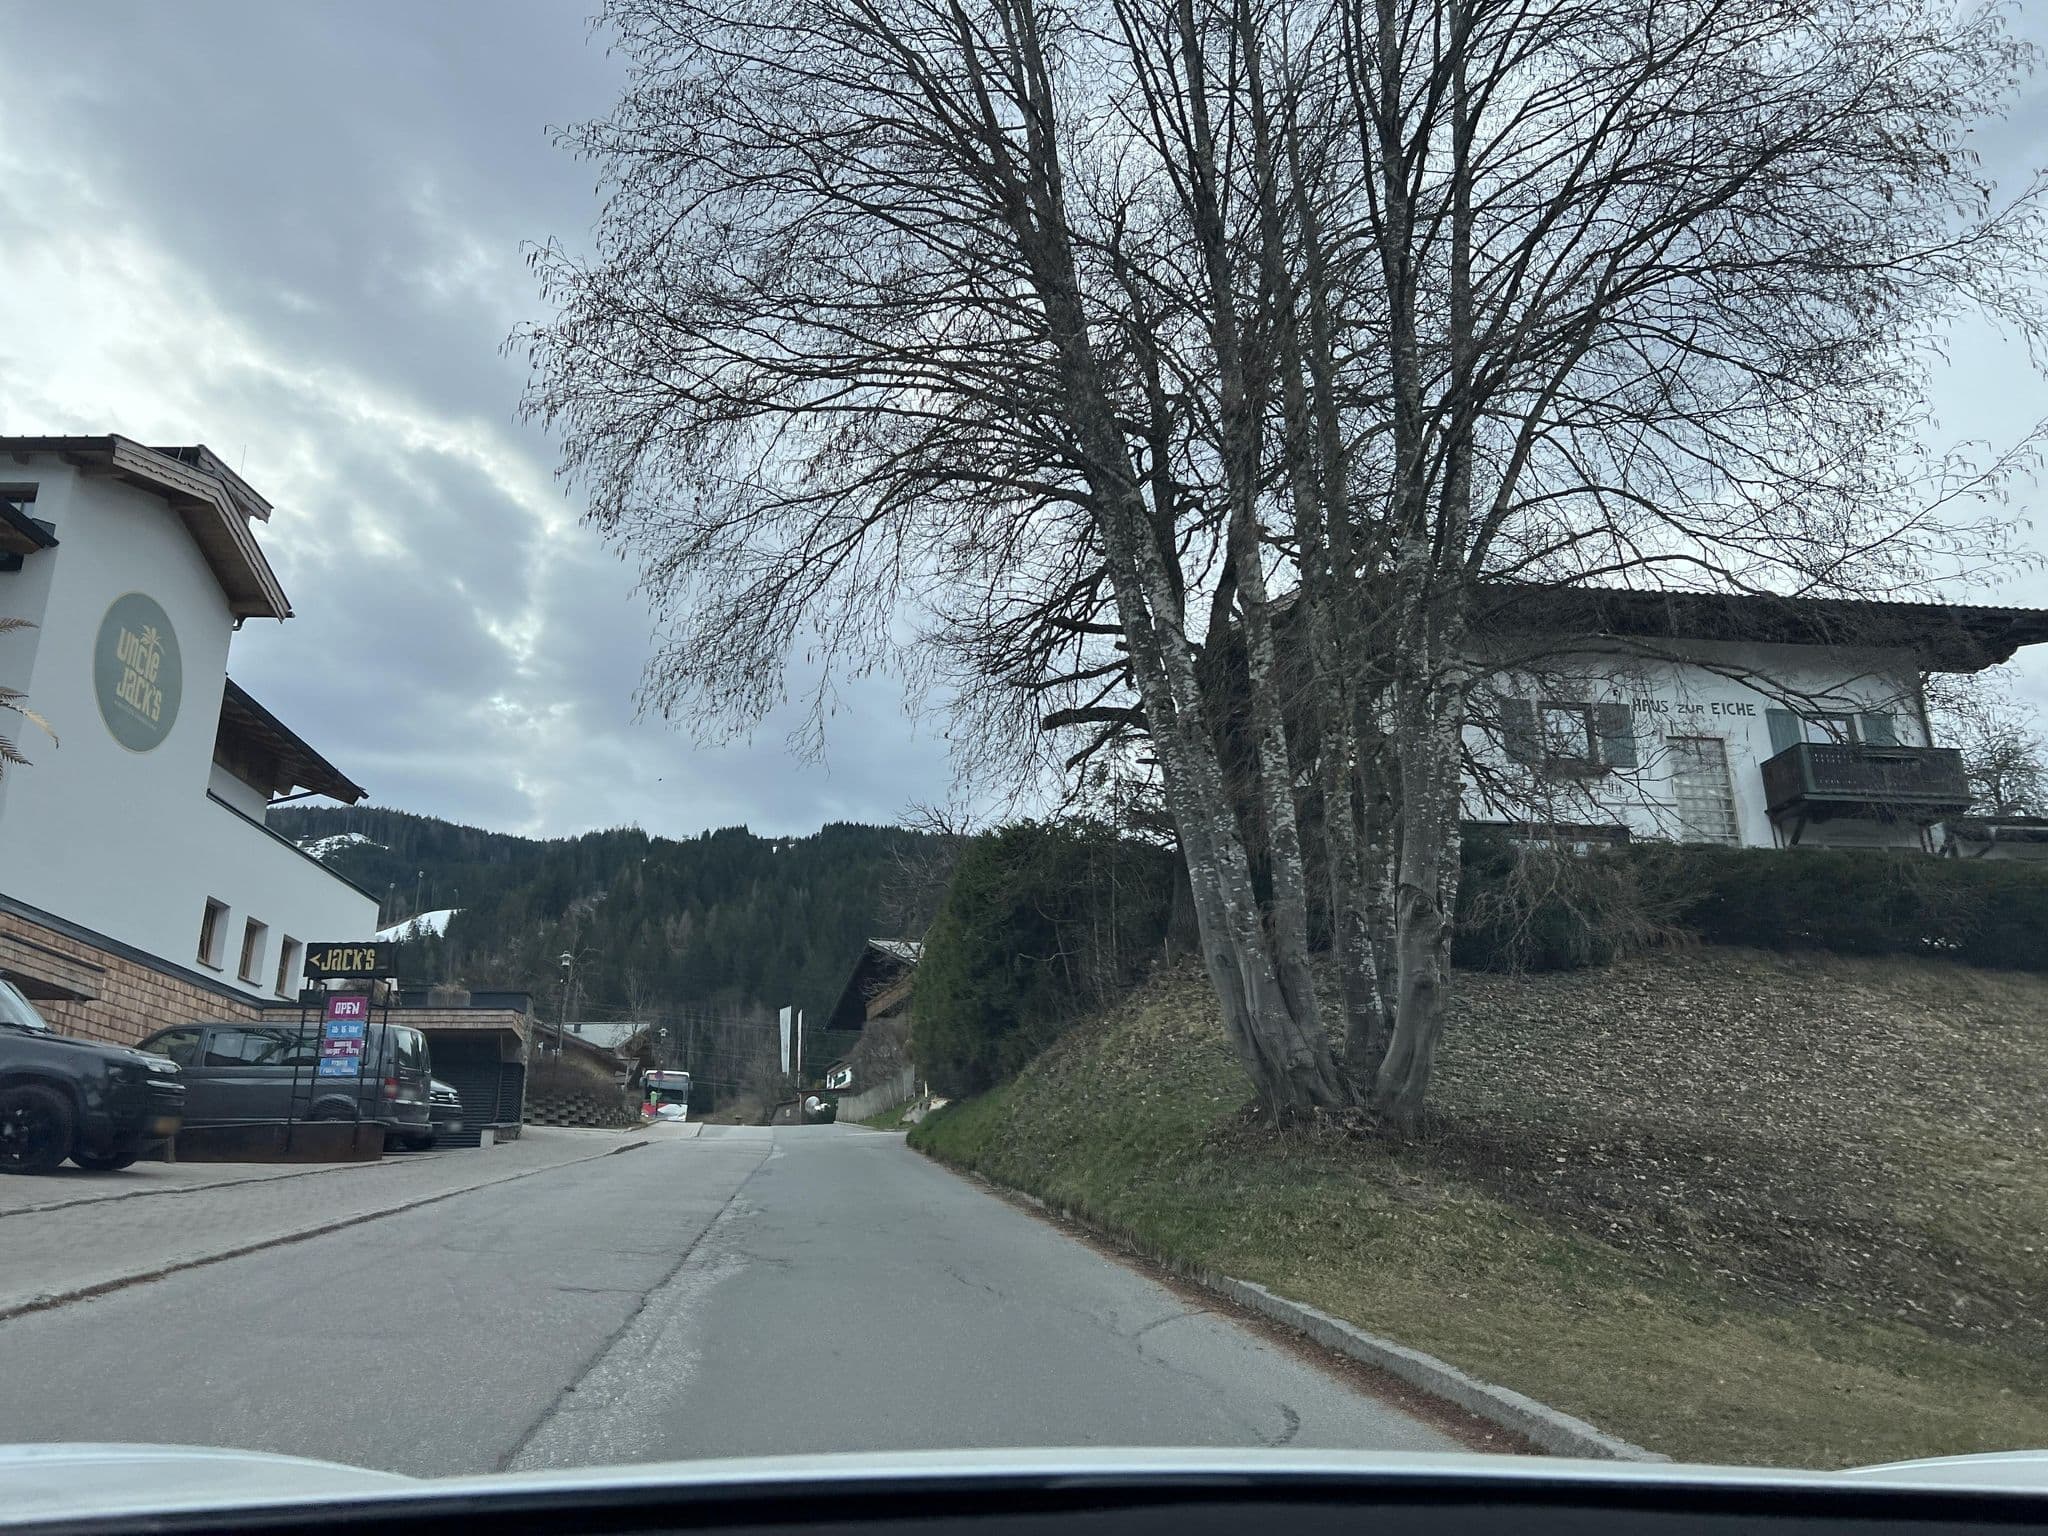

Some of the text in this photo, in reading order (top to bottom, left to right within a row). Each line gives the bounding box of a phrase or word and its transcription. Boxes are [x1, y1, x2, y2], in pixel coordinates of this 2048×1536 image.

[1632, 698, 1757, 717] HAUS ZUR EICHE
[334, 1001, 361, 1015] OPEN
